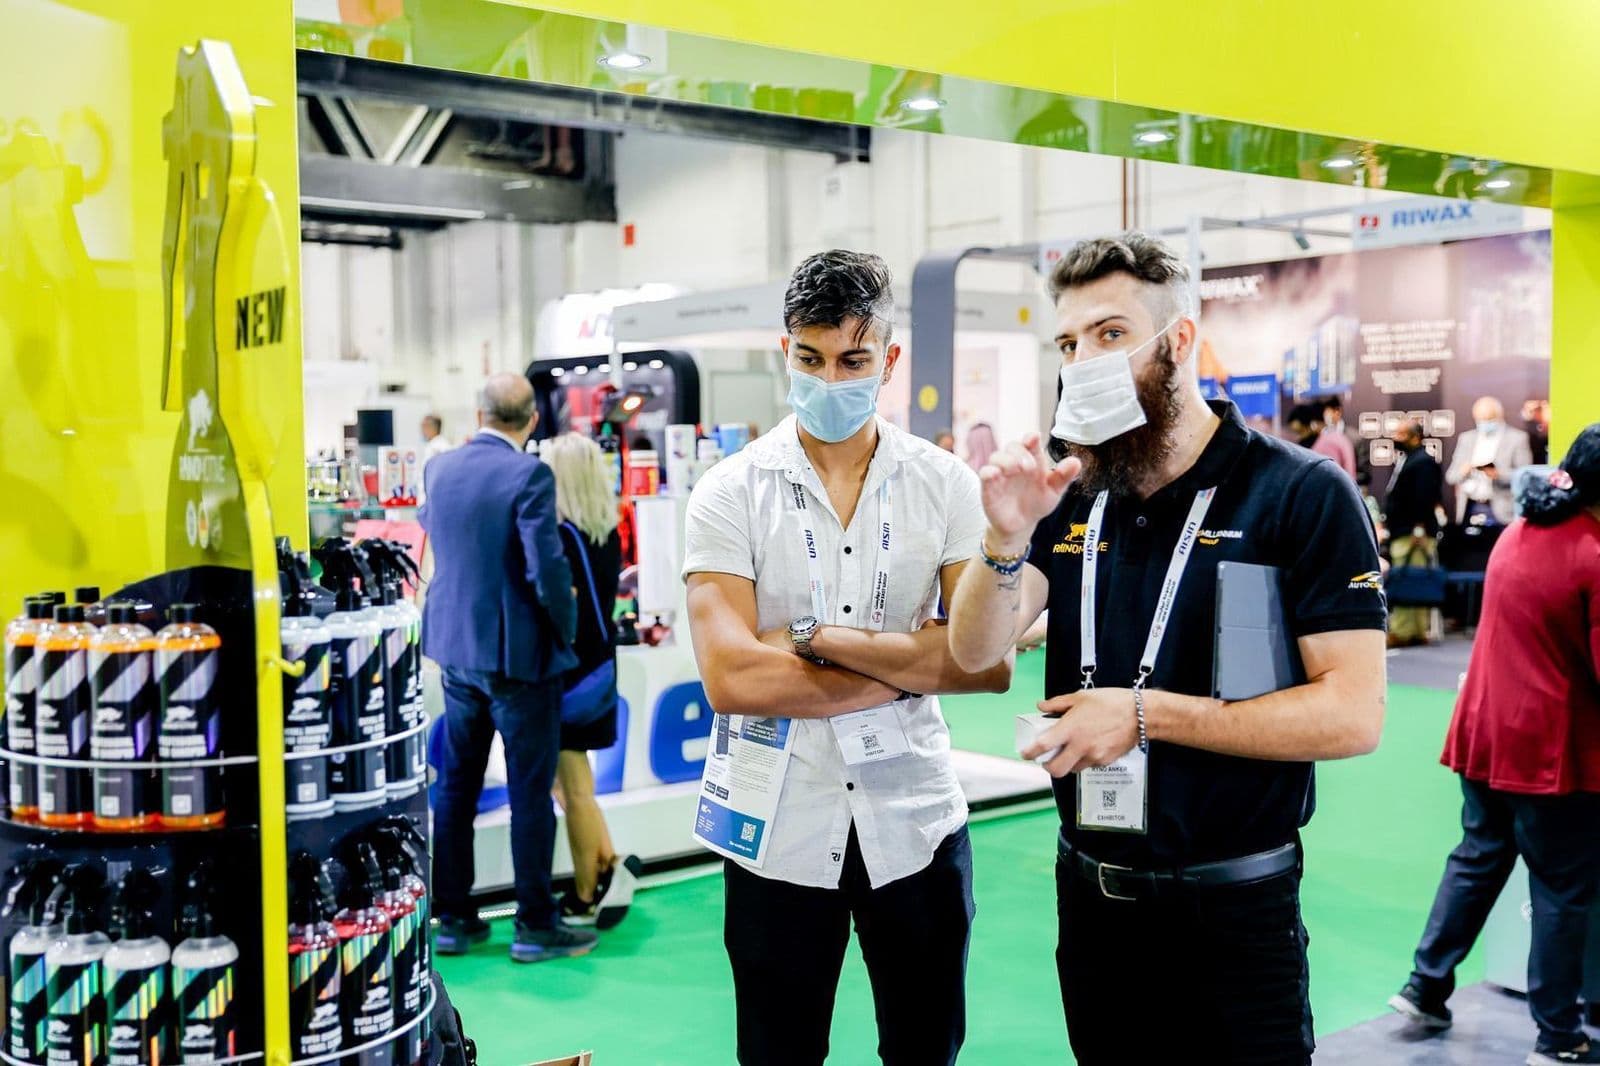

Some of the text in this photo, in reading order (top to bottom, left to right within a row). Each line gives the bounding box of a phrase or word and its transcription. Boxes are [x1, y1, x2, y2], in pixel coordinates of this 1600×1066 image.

[1392, 203, 1473, 228] RIWAX
[236, 286, 286, 350] NEW
[804, 530, 816, 558] AISIN
[882, 522, 890, 551] AISIN
[1179, 521, 1197, 555] AISIN
